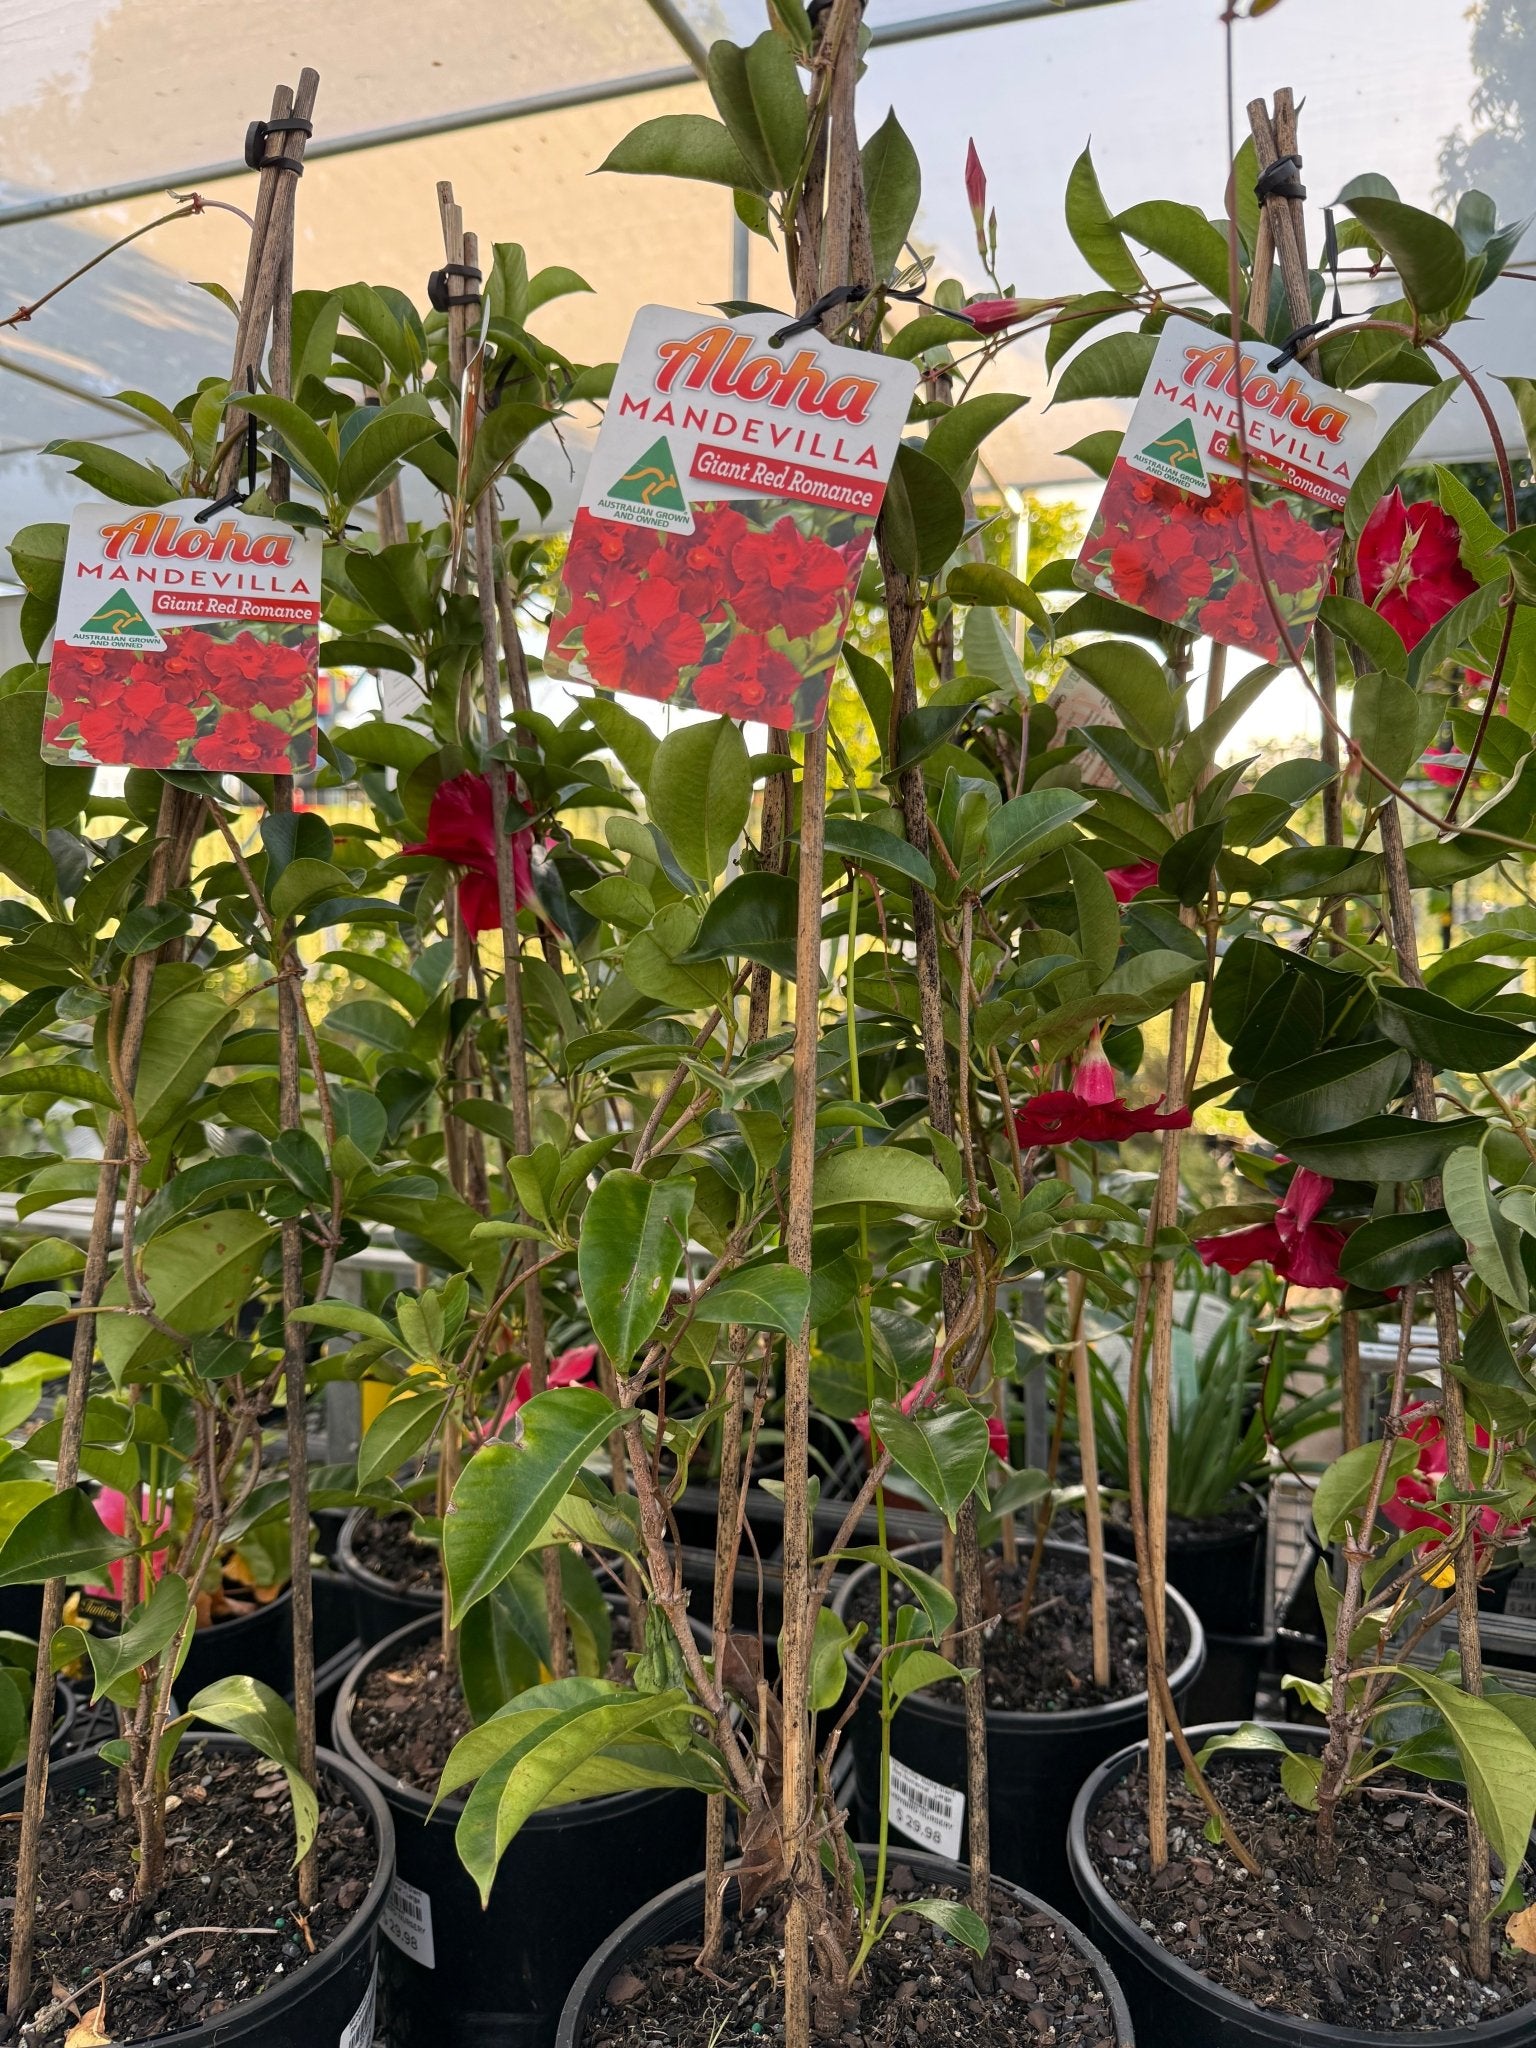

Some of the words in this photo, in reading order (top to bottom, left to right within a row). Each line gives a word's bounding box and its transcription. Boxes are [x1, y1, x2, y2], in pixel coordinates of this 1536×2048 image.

[655, 326, 880, 426] Aloha
[1182, 345, 1350, 445] Aloha
[619, 393, 879, 470] MANDEVILLA
[1154, 378, 1350, 481] MANDEVILLA
[698, 451, 749, 481] Giant
[750, 463, 787, 489] Red
[788, 471, 873, 507] Romance
[1133, 454, 1178, 476] AUSTRALIAN
[1180, 473, 1207, 488] GROWN
[1146, 466, 1162, 476] AND
[1164, 474, 1190, 488] OWNED
[1283, 468, 1346, 507] Romance
[598, 499, 653, 516] AUSTRALIAN
[656, 511, 690, 524] GROWN
[613, 511, 634, 521] AND
[635, 516, 669, 528] OWNED
[100, 511, 293, 568] Aloha
[77, 562, 311, 594] MANDEVILLA
[157, 595, 204, 612] Giant
[207, 597, 237, 615] Red
[240, 601, 312, 620] Romance
[73, 633, 126, 642] AUSTRALIAN
